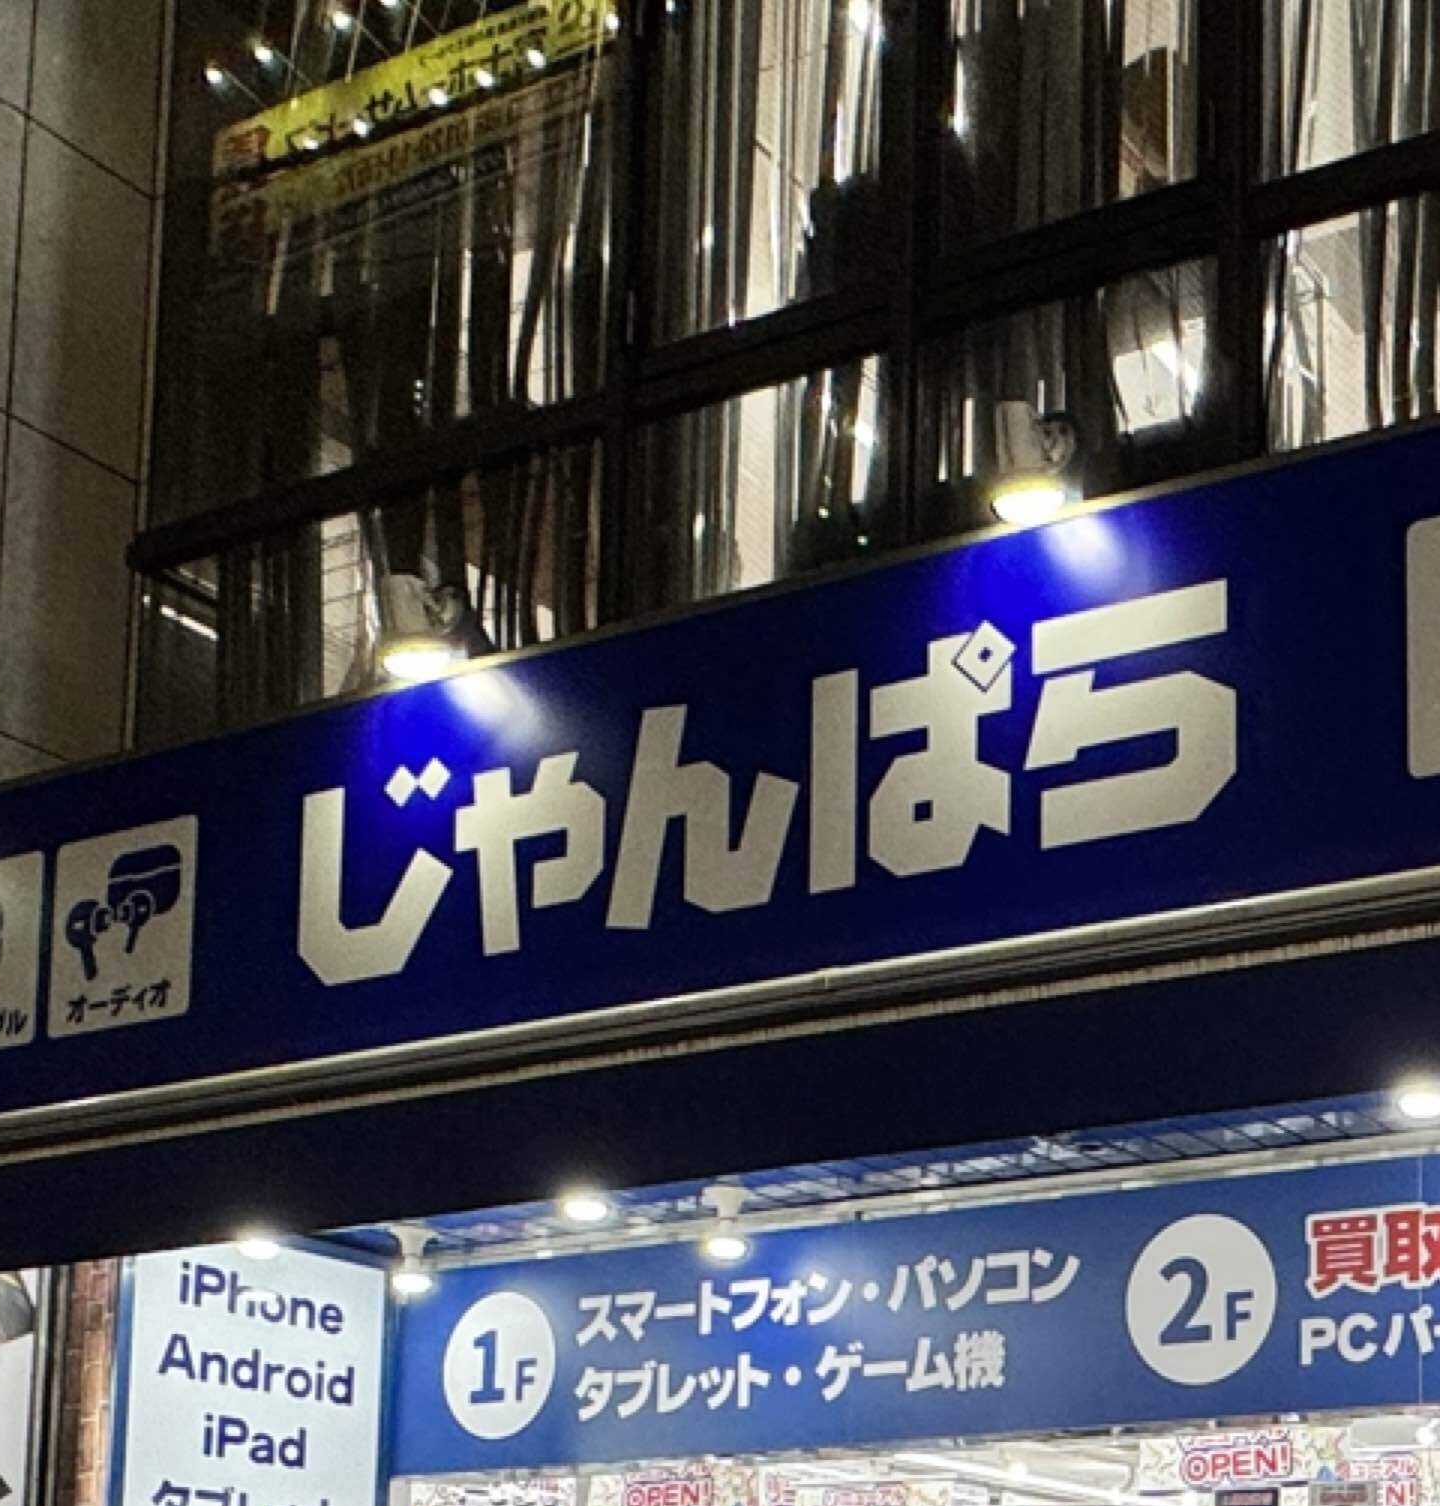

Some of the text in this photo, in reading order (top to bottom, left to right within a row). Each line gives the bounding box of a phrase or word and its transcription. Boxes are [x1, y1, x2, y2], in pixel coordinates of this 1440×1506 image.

[298, 580, 1237, 986] じゃんぱら
[65, 980, 171, 1024] オーディオ
[178, 1262, 344, 1335] iPhone
[576, 1250, 1081, 1346] スマートフォン・パソコン
[1159, 1257, 1252, 1346] 2F
[158, 1333, 355, 1406] Android
[469, 1328, 537, 1403] 1F
[575, 1329, 1007, 1421] タブレット・ゲーム機
[202, 1413, 308, 1469] iPad
[1185, 1442, 1292, 1482] OPEN!
